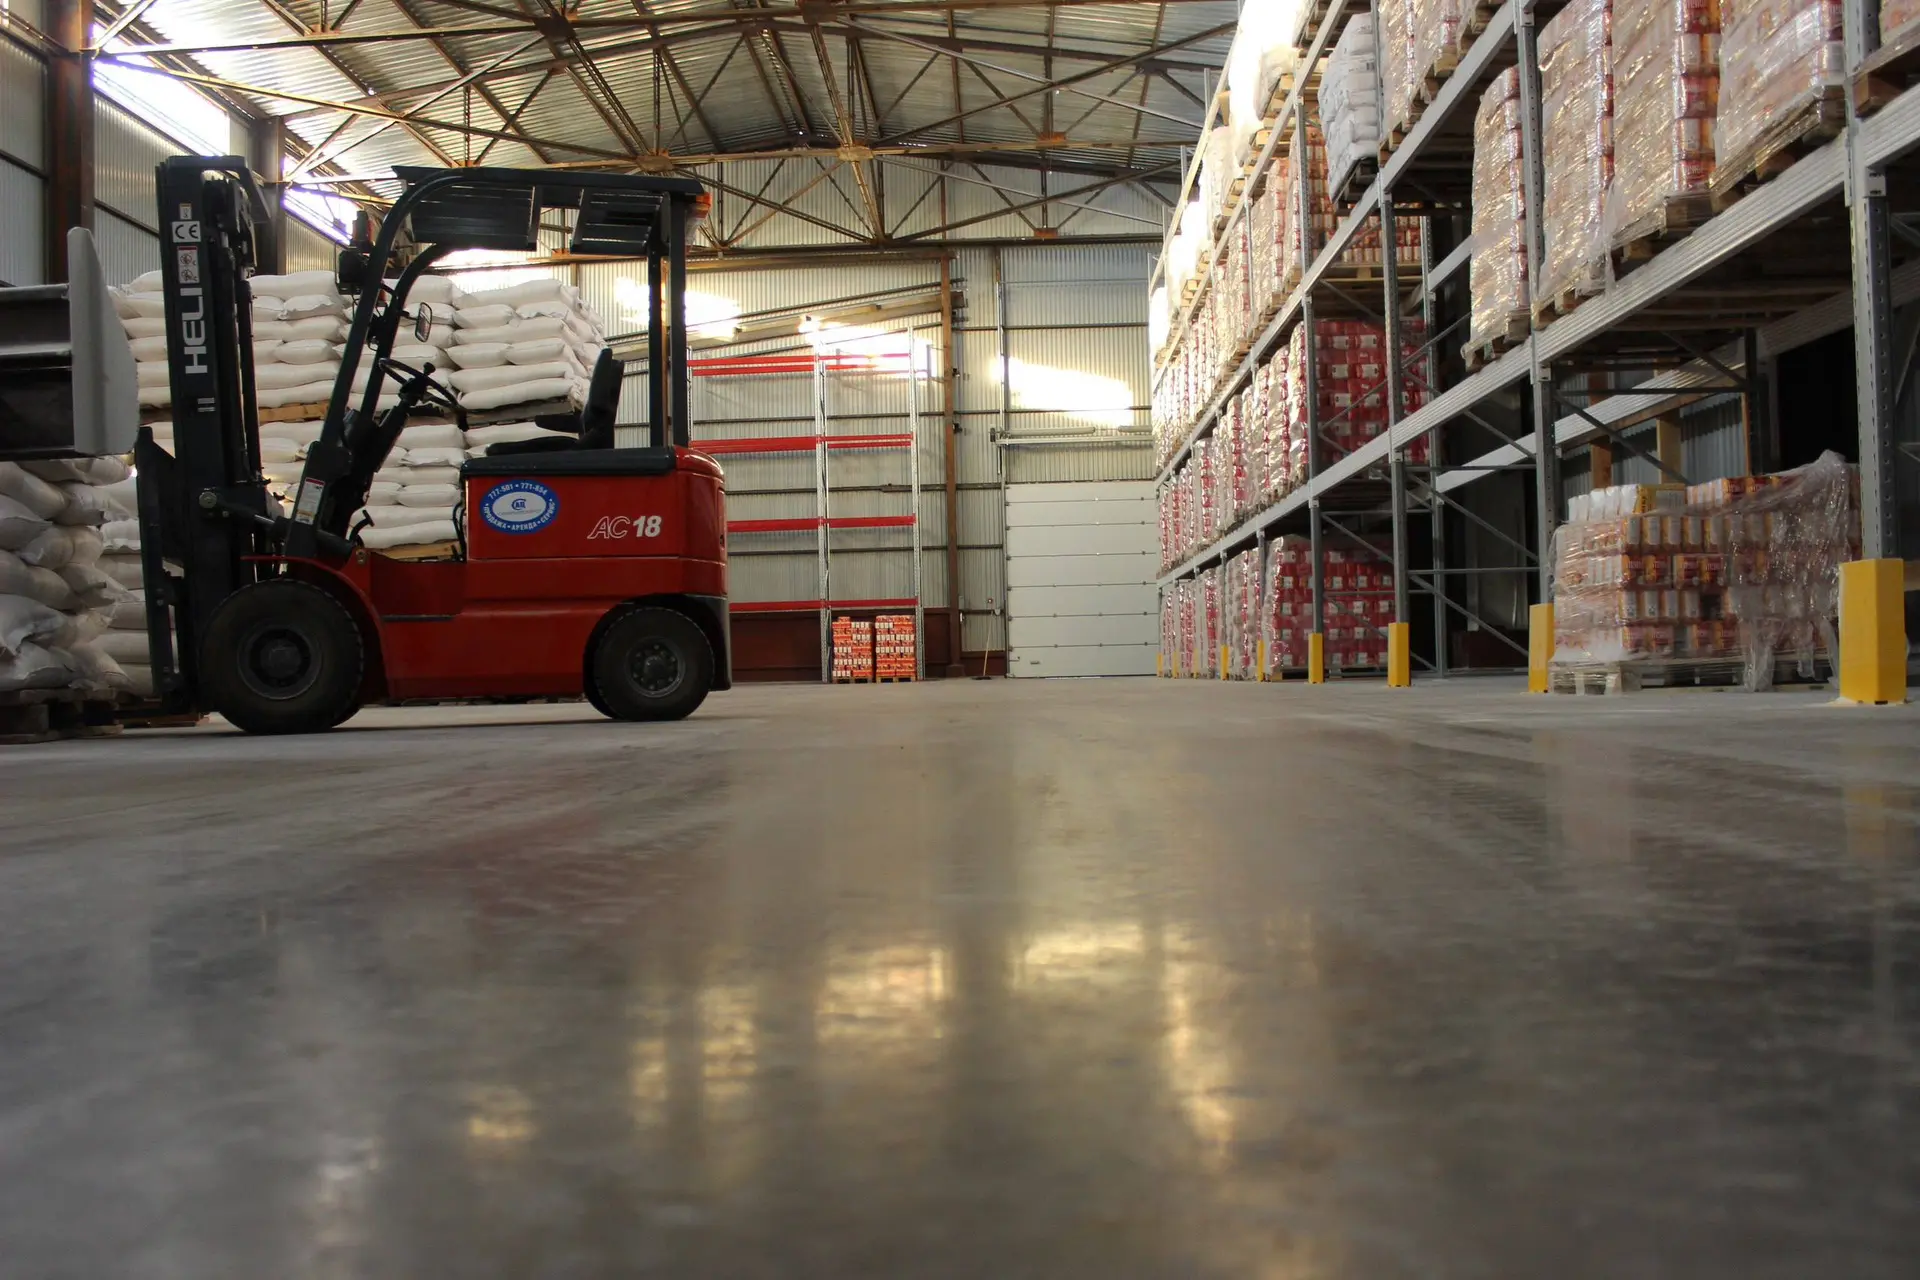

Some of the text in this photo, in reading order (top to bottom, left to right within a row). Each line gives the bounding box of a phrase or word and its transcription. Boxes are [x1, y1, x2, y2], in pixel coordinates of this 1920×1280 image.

[175, 223, 199, 239] CE
[180, 287, 208, 374] HELI
[511, 521, 538, 531] АРЕНДА
